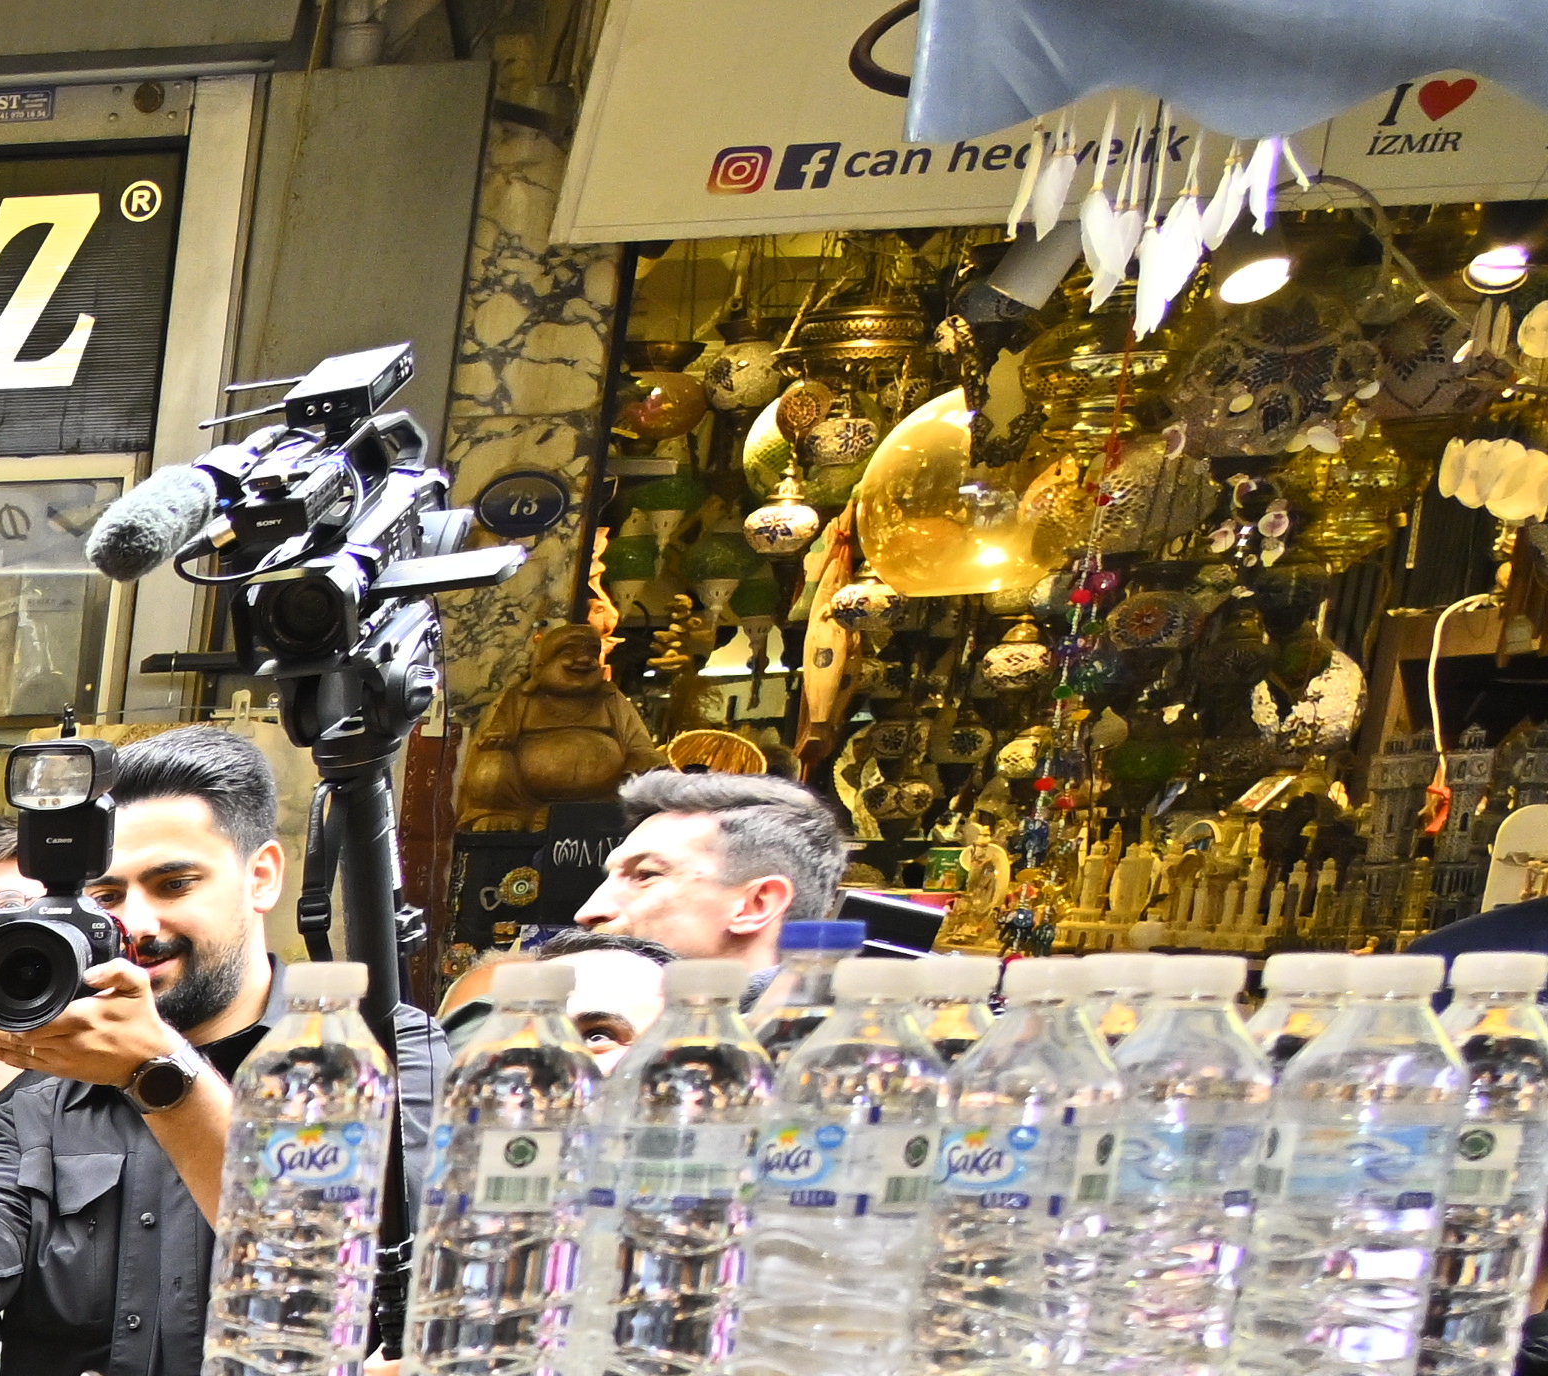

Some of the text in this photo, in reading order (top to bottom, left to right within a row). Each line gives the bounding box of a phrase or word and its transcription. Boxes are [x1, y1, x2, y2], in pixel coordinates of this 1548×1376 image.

[1377, 83, 1414, 126] I
[1366, 127, 1463, 156] İZMİR
[844, 148, 932, 178] can
[509, 492, 539, 516] 73
[256, 517, 282, 528] SONY
[38, 907, 73, 915] Canon
